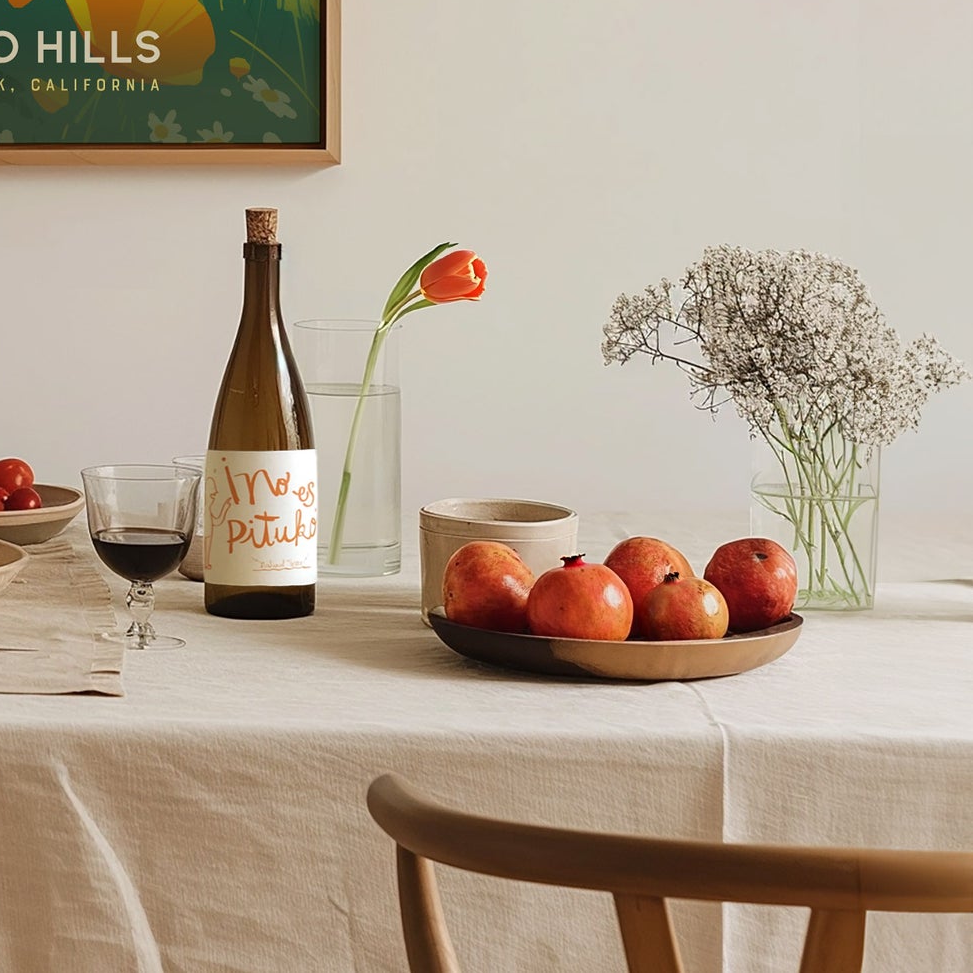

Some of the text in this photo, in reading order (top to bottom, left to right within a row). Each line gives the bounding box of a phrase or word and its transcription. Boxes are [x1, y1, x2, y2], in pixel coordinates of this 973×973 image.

[36, 30, 161, 64] HILLS
[30, 78, 160, 92] CALIFORNIA
[292, 481, 315, 508] es
